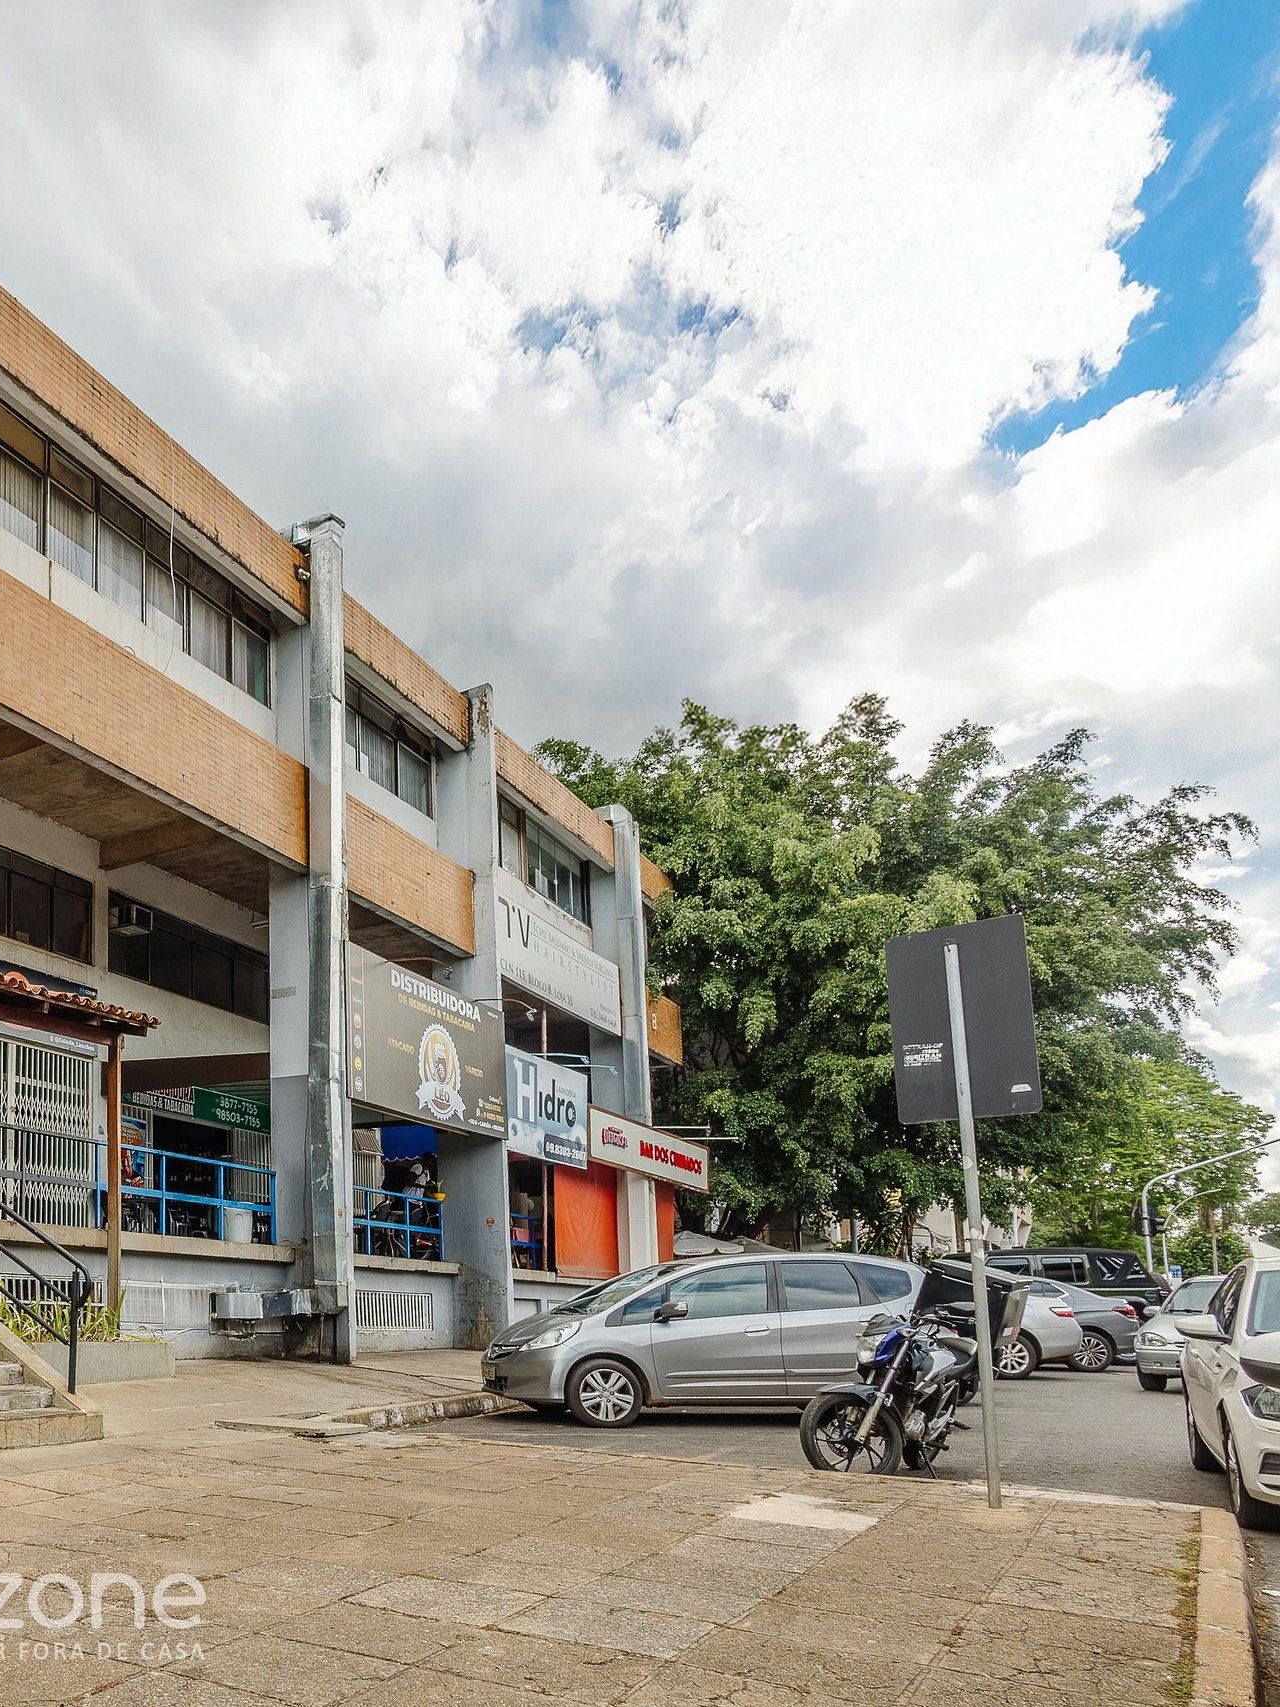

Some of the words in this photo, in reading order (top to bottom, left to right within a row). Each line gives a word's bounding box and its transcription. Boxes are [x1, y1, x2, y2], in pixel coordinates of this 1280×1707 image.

[500, 958, 514, 974] CLN
[391, 969, 481, 1022] DISTRIBUIDORA
[398, 993, 407, 1005] DE
[409, 999, 436, 1018] BEBIDAS
[442, 1012, 475, 1033] TABACARIA
[388, 1038, 414, 1055] ATACADO
[132, 1091, 158, 1109] BEBIDAS
[164, 1098, 194, 1116] TABACARIA
[513, 1057, 577, 1128] Hidro
[220, 1096, 258, 1115] 3877-7155
[215, 1108, 261, 1129] 98503-7155
[639, 1140, 654, 1159] BAR
[654, 1144, 669, 1164] DOS
